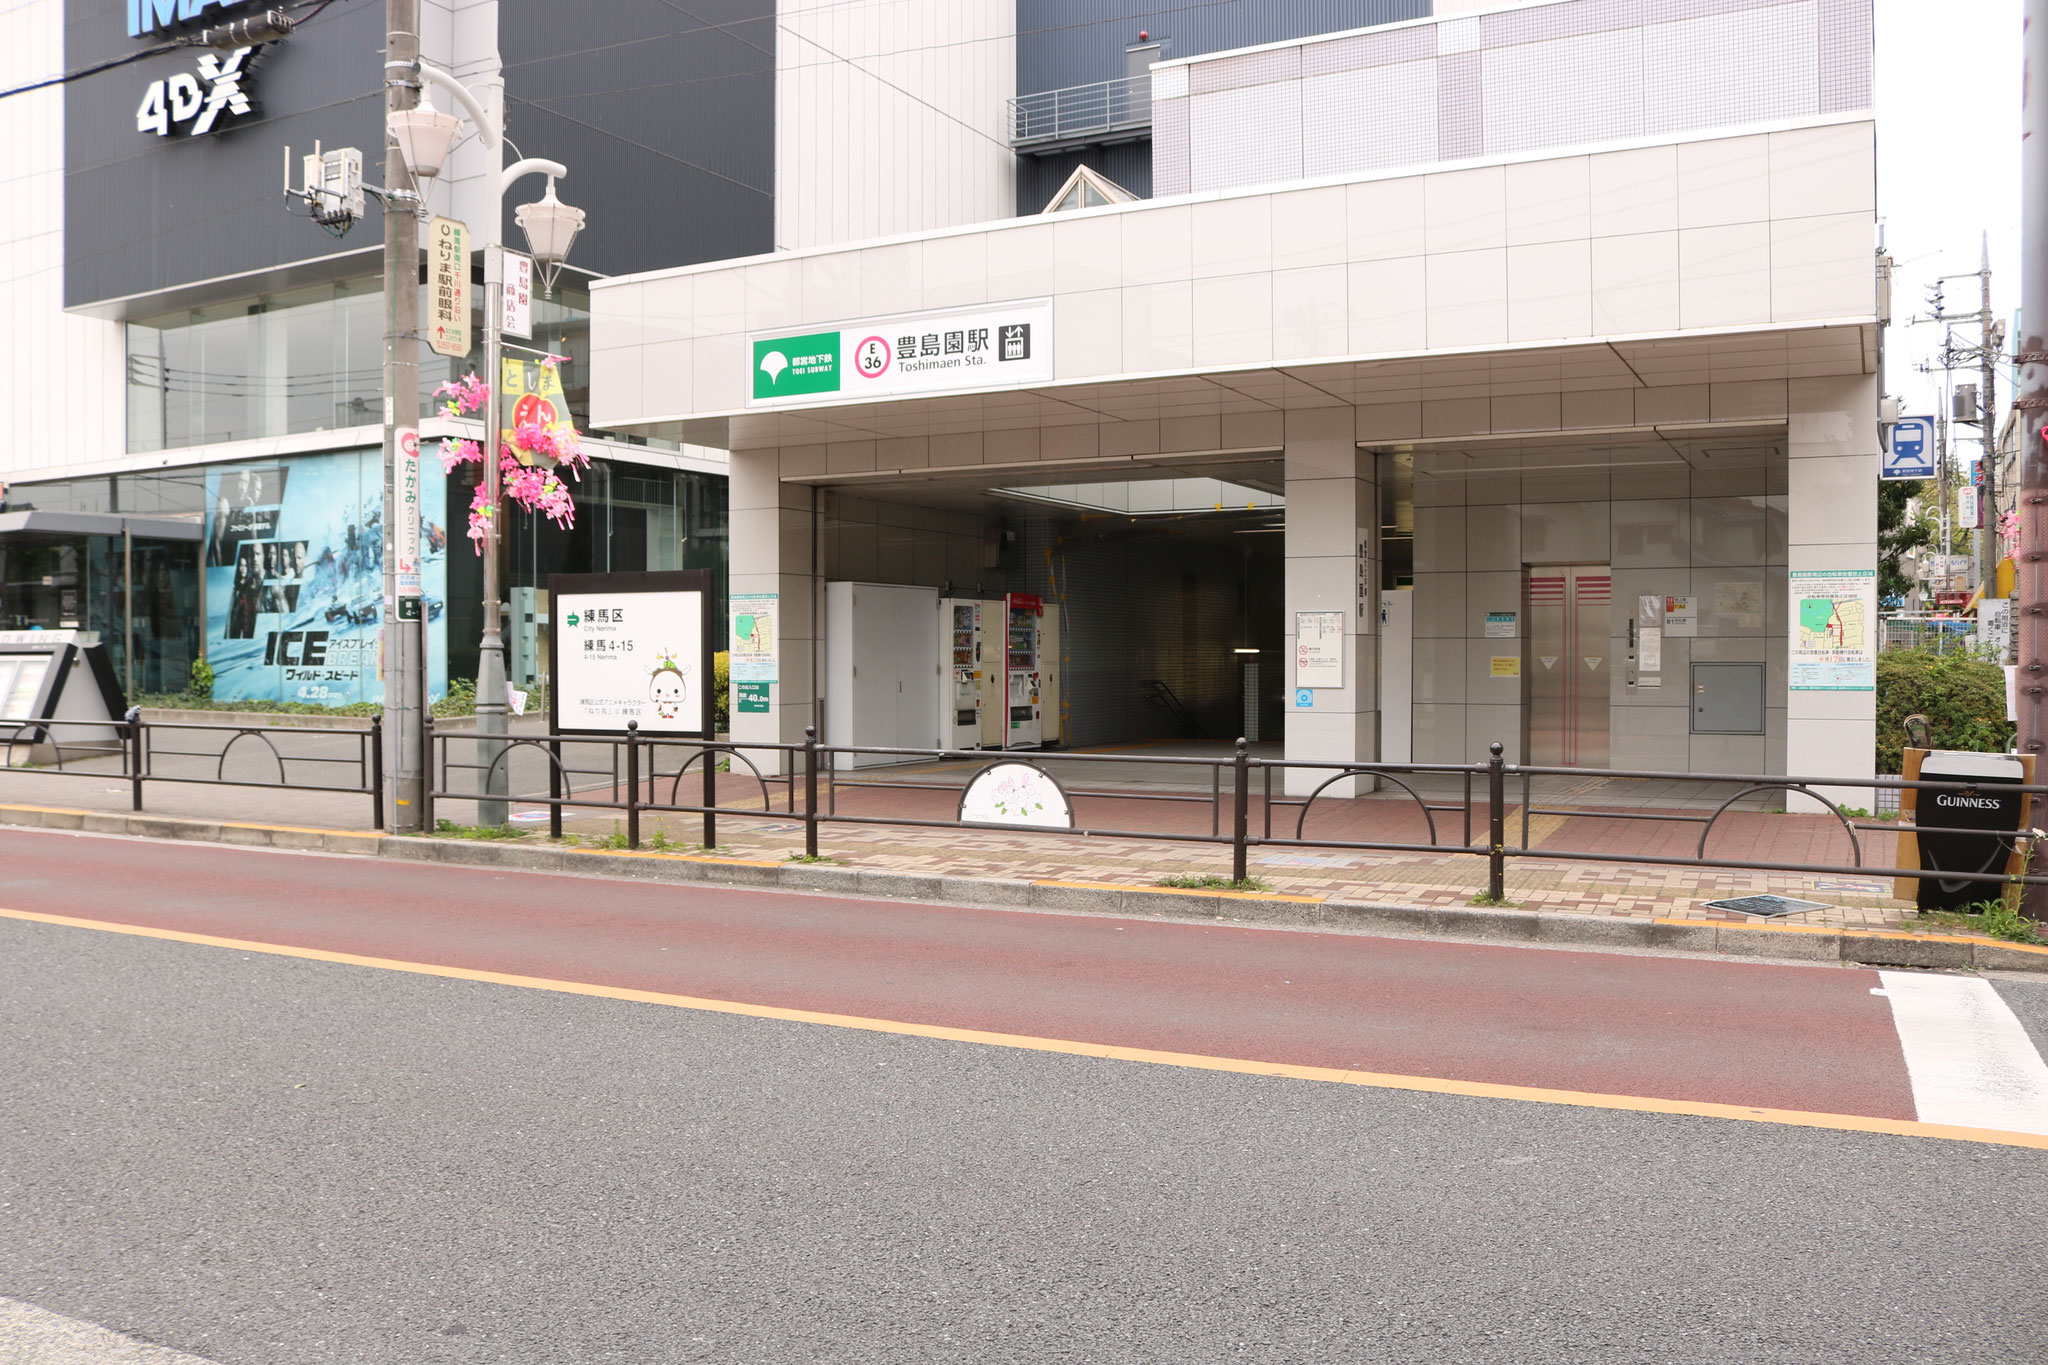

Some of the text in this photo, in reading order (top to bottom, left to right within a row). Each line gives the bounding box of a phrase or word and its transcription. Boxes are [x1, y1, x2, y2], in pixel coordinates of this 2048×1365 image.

[128, 0, 246, 37] IM
[136, 46, 252, 136] 4DX
[438, 239, 453, 322] ねりま駅前眼科
[518, 260, 528, 306] 豊島園
[505, 283, 515, 329] 商店会
[869, 343, 876, 355] E
[896, 328, 989, 360] 豊島園駅
[792, 353, 833, 368] 都営地下鉄
[792, 364, 833, 376] TOEI SUBWAY
[864, 356, 882, 369] 36
[898, 354, 987, 373] Toshimaen Sta.
[505, 369, 554, 391] としま
[520, 404, 552, 430] えん
[404, 459, 417, 555] たかみクリニック
[583, 608, 624, 623] 練馬区
[583, 625, 595, 633] City
[264, 631, 330, 666] ICE
[285, 669, 359, 680] ワイルド・スピード
[297, 685, 329, 699] 4.28
[1936, 794, 2000, 810] GUINNESS
